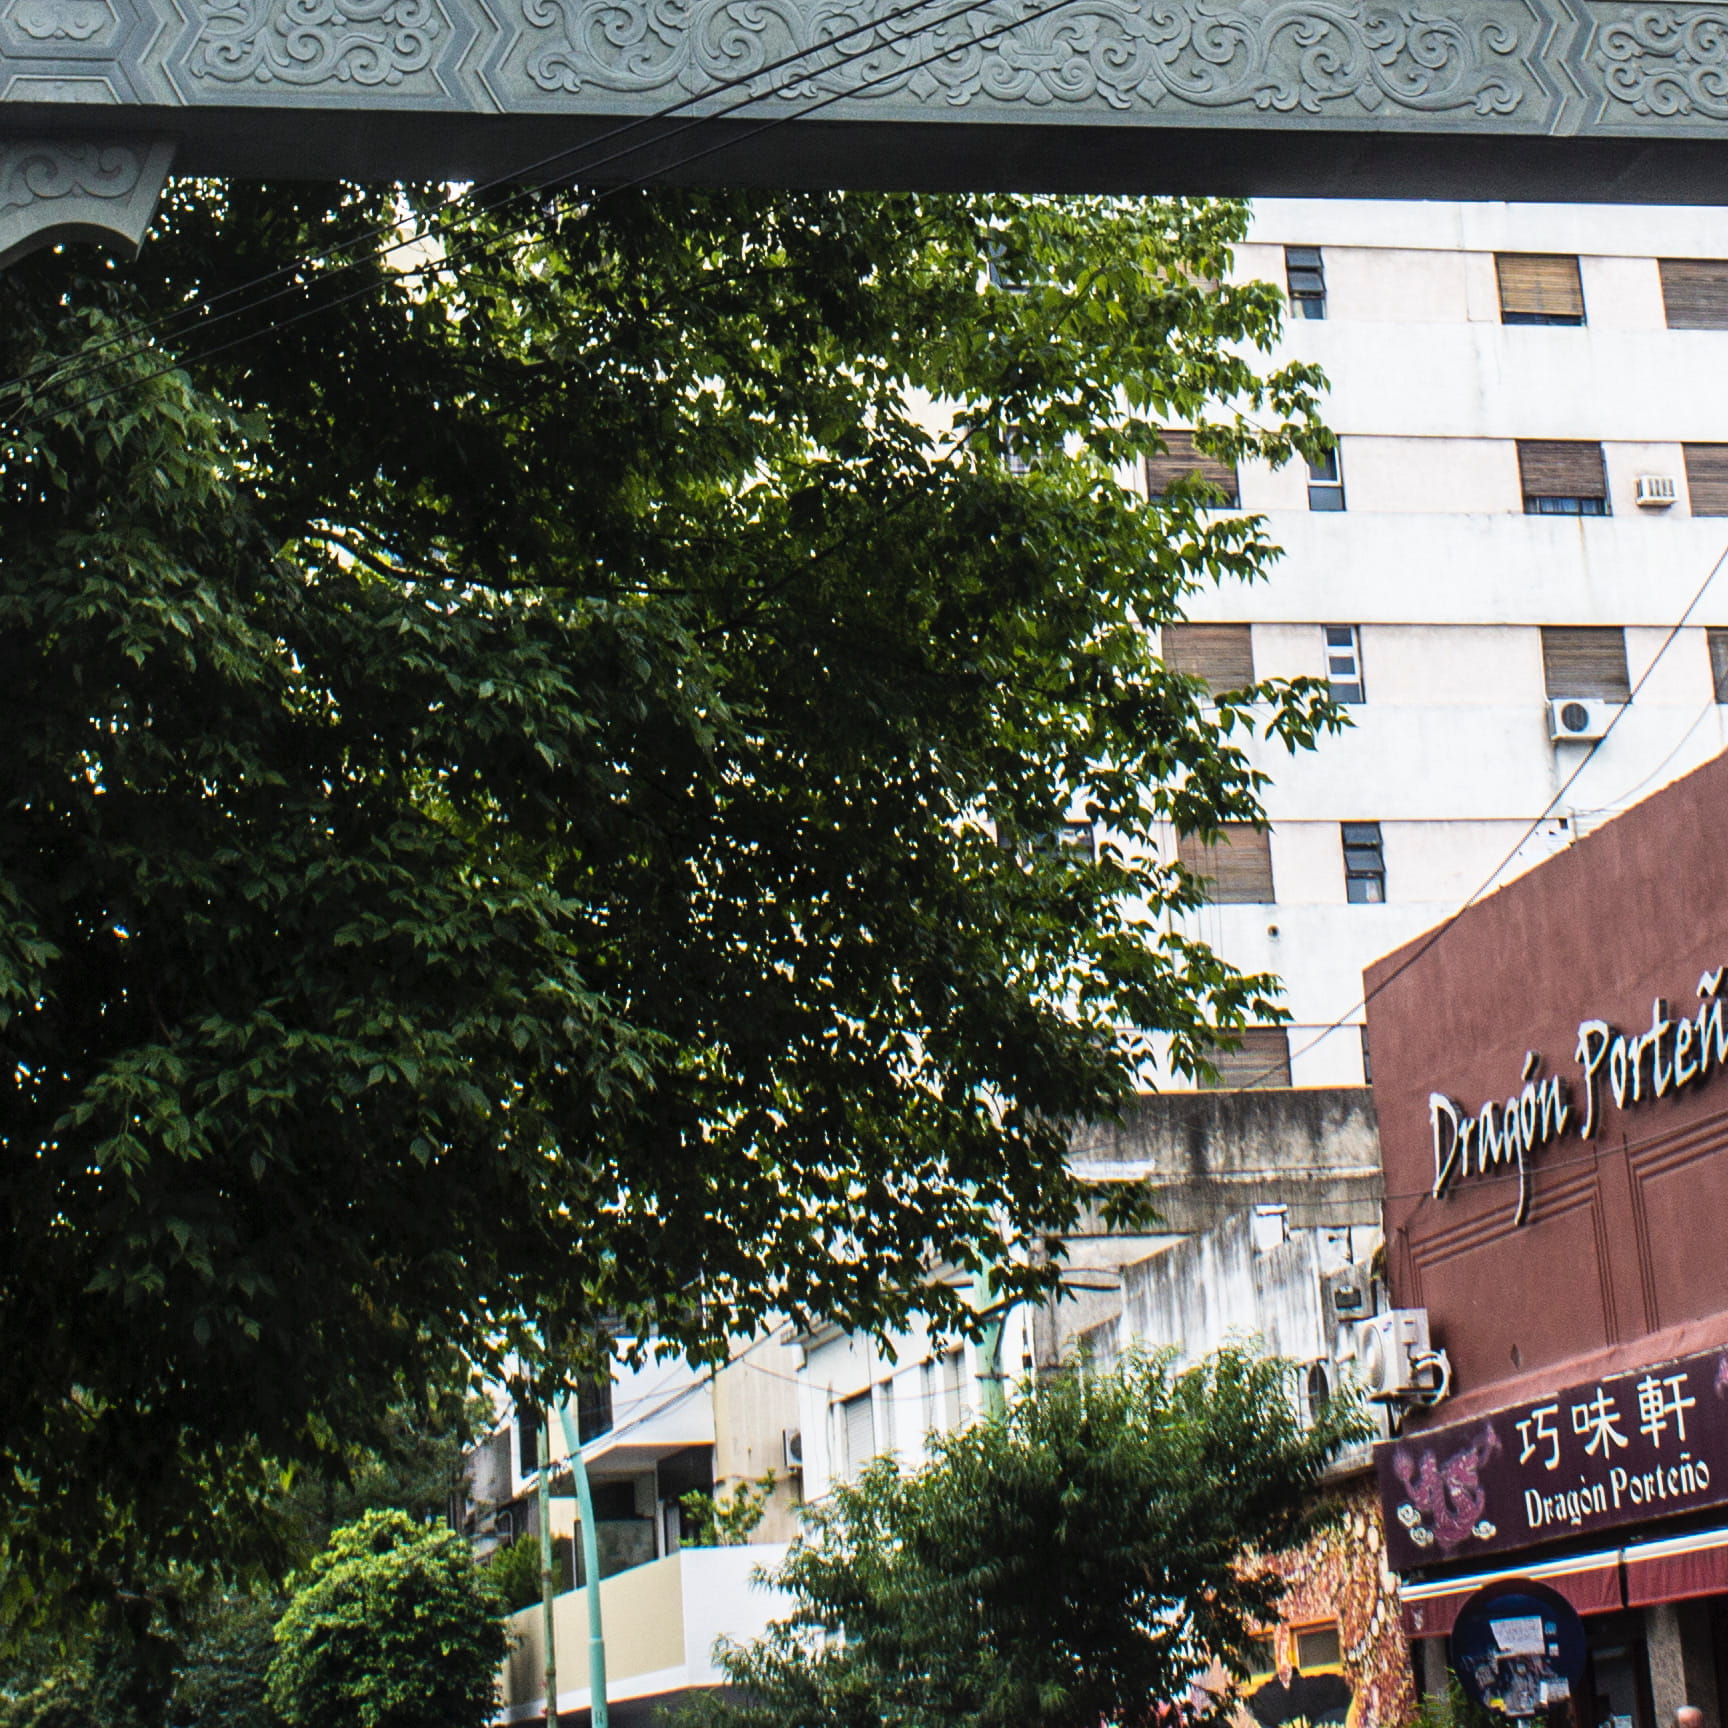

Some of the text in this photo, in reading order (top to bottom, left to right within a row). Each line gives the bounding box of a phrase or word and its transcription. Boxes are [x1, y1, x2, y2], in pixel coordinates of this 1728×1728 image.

[1429, 1049, 1568, 1227] Dragón
[1515, 1373, 1697, 1471] 巧味軒
[1609, 1451, 1711, 1509] Porteño
